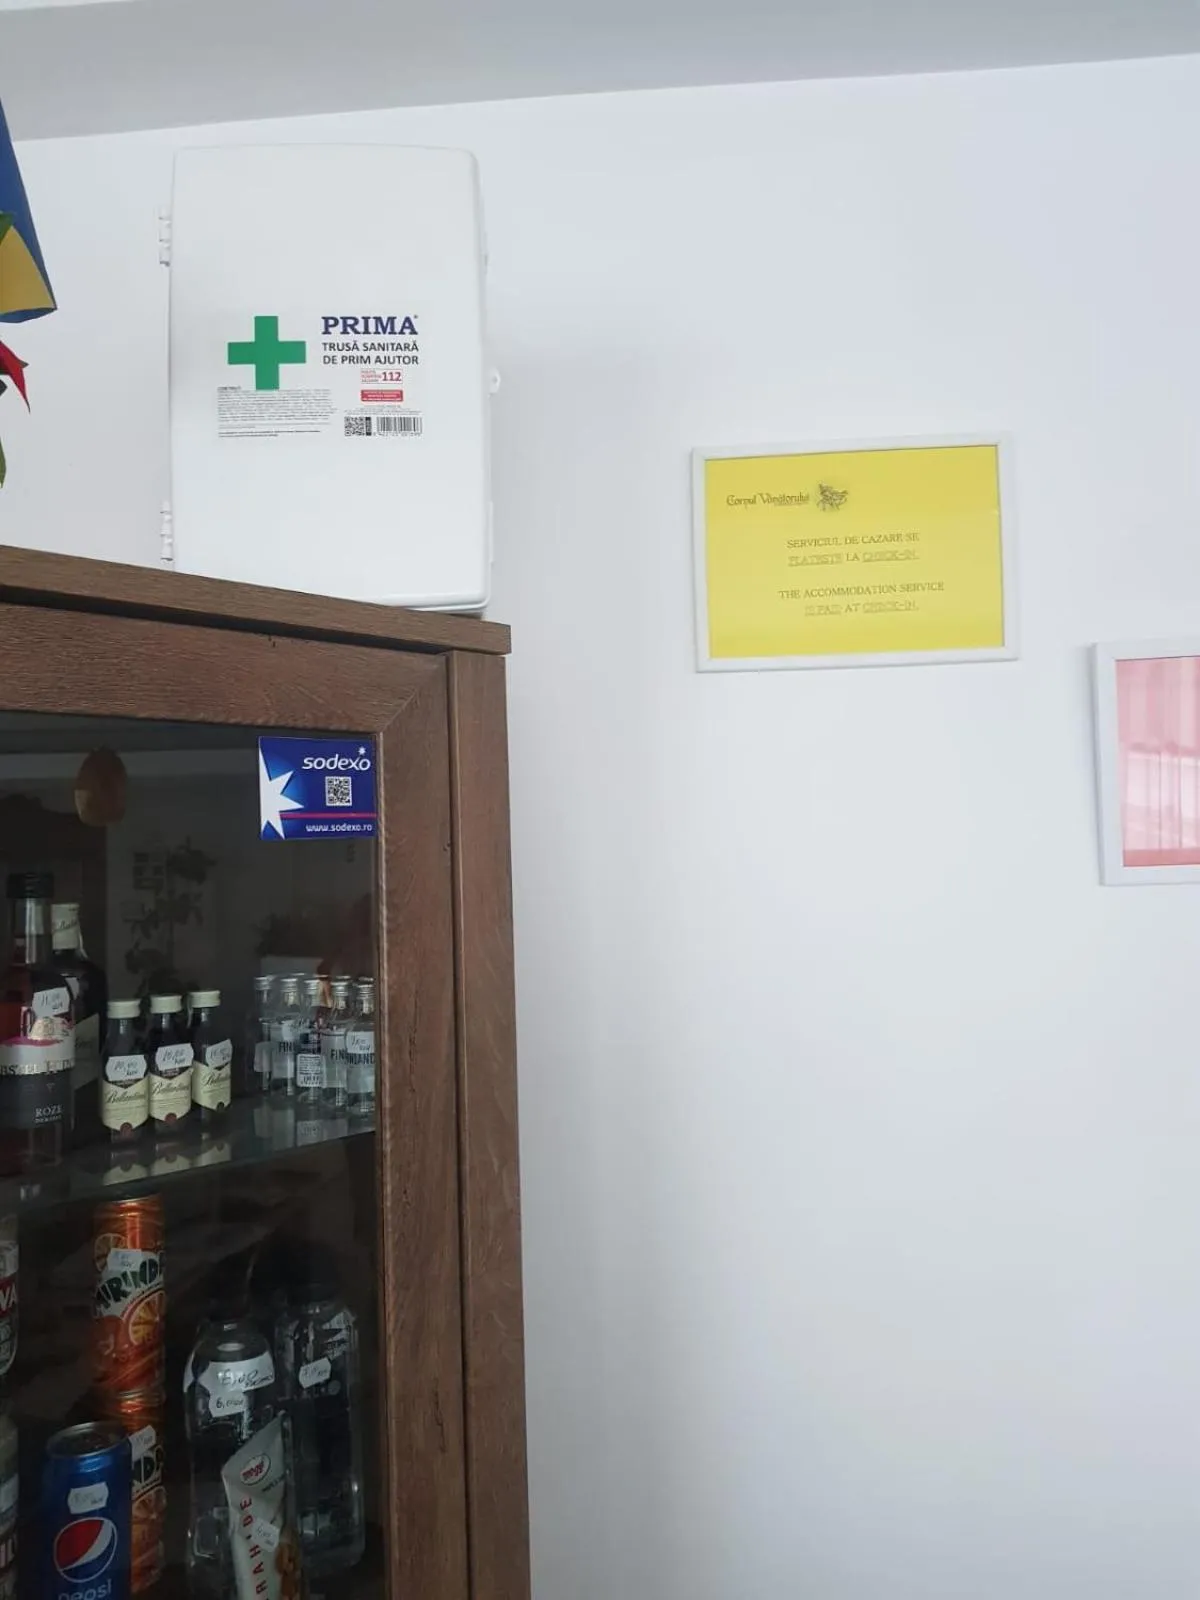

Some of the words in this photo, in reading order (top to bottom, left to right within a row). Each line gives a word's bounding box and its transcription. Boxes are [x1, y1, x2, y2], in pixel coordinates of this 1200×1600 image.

[321, 316, 418, 335] PRIMA
[322, 340, 360, 352] TRUSĂ
[362, 340, 419, 352] SANITARĂ
[323, 355, 338, 365] DE
[340, 355, 371, 365] PRIM
[374, 355, 419, 365] AJUTOR
[382, 371, 402, 382] 112
[787, 537, 843, 549] SERVICIUL
[844, 535, 859, 545] DE
[861, 533, 903, 545] CAZARE
[904, 532, 920, 543] SE
[846, 552, 860, 562] LA
[778, 589, 801, 600] THE
[803, 584, 897, 599] ACCOMMODATION
[899, 581, 945, 594] SERVICE
[844, 602, 861, 613] AT
[301, 753, 371, 771] sodexo
[305, 822, 373, 832] www.sodexo.ro
